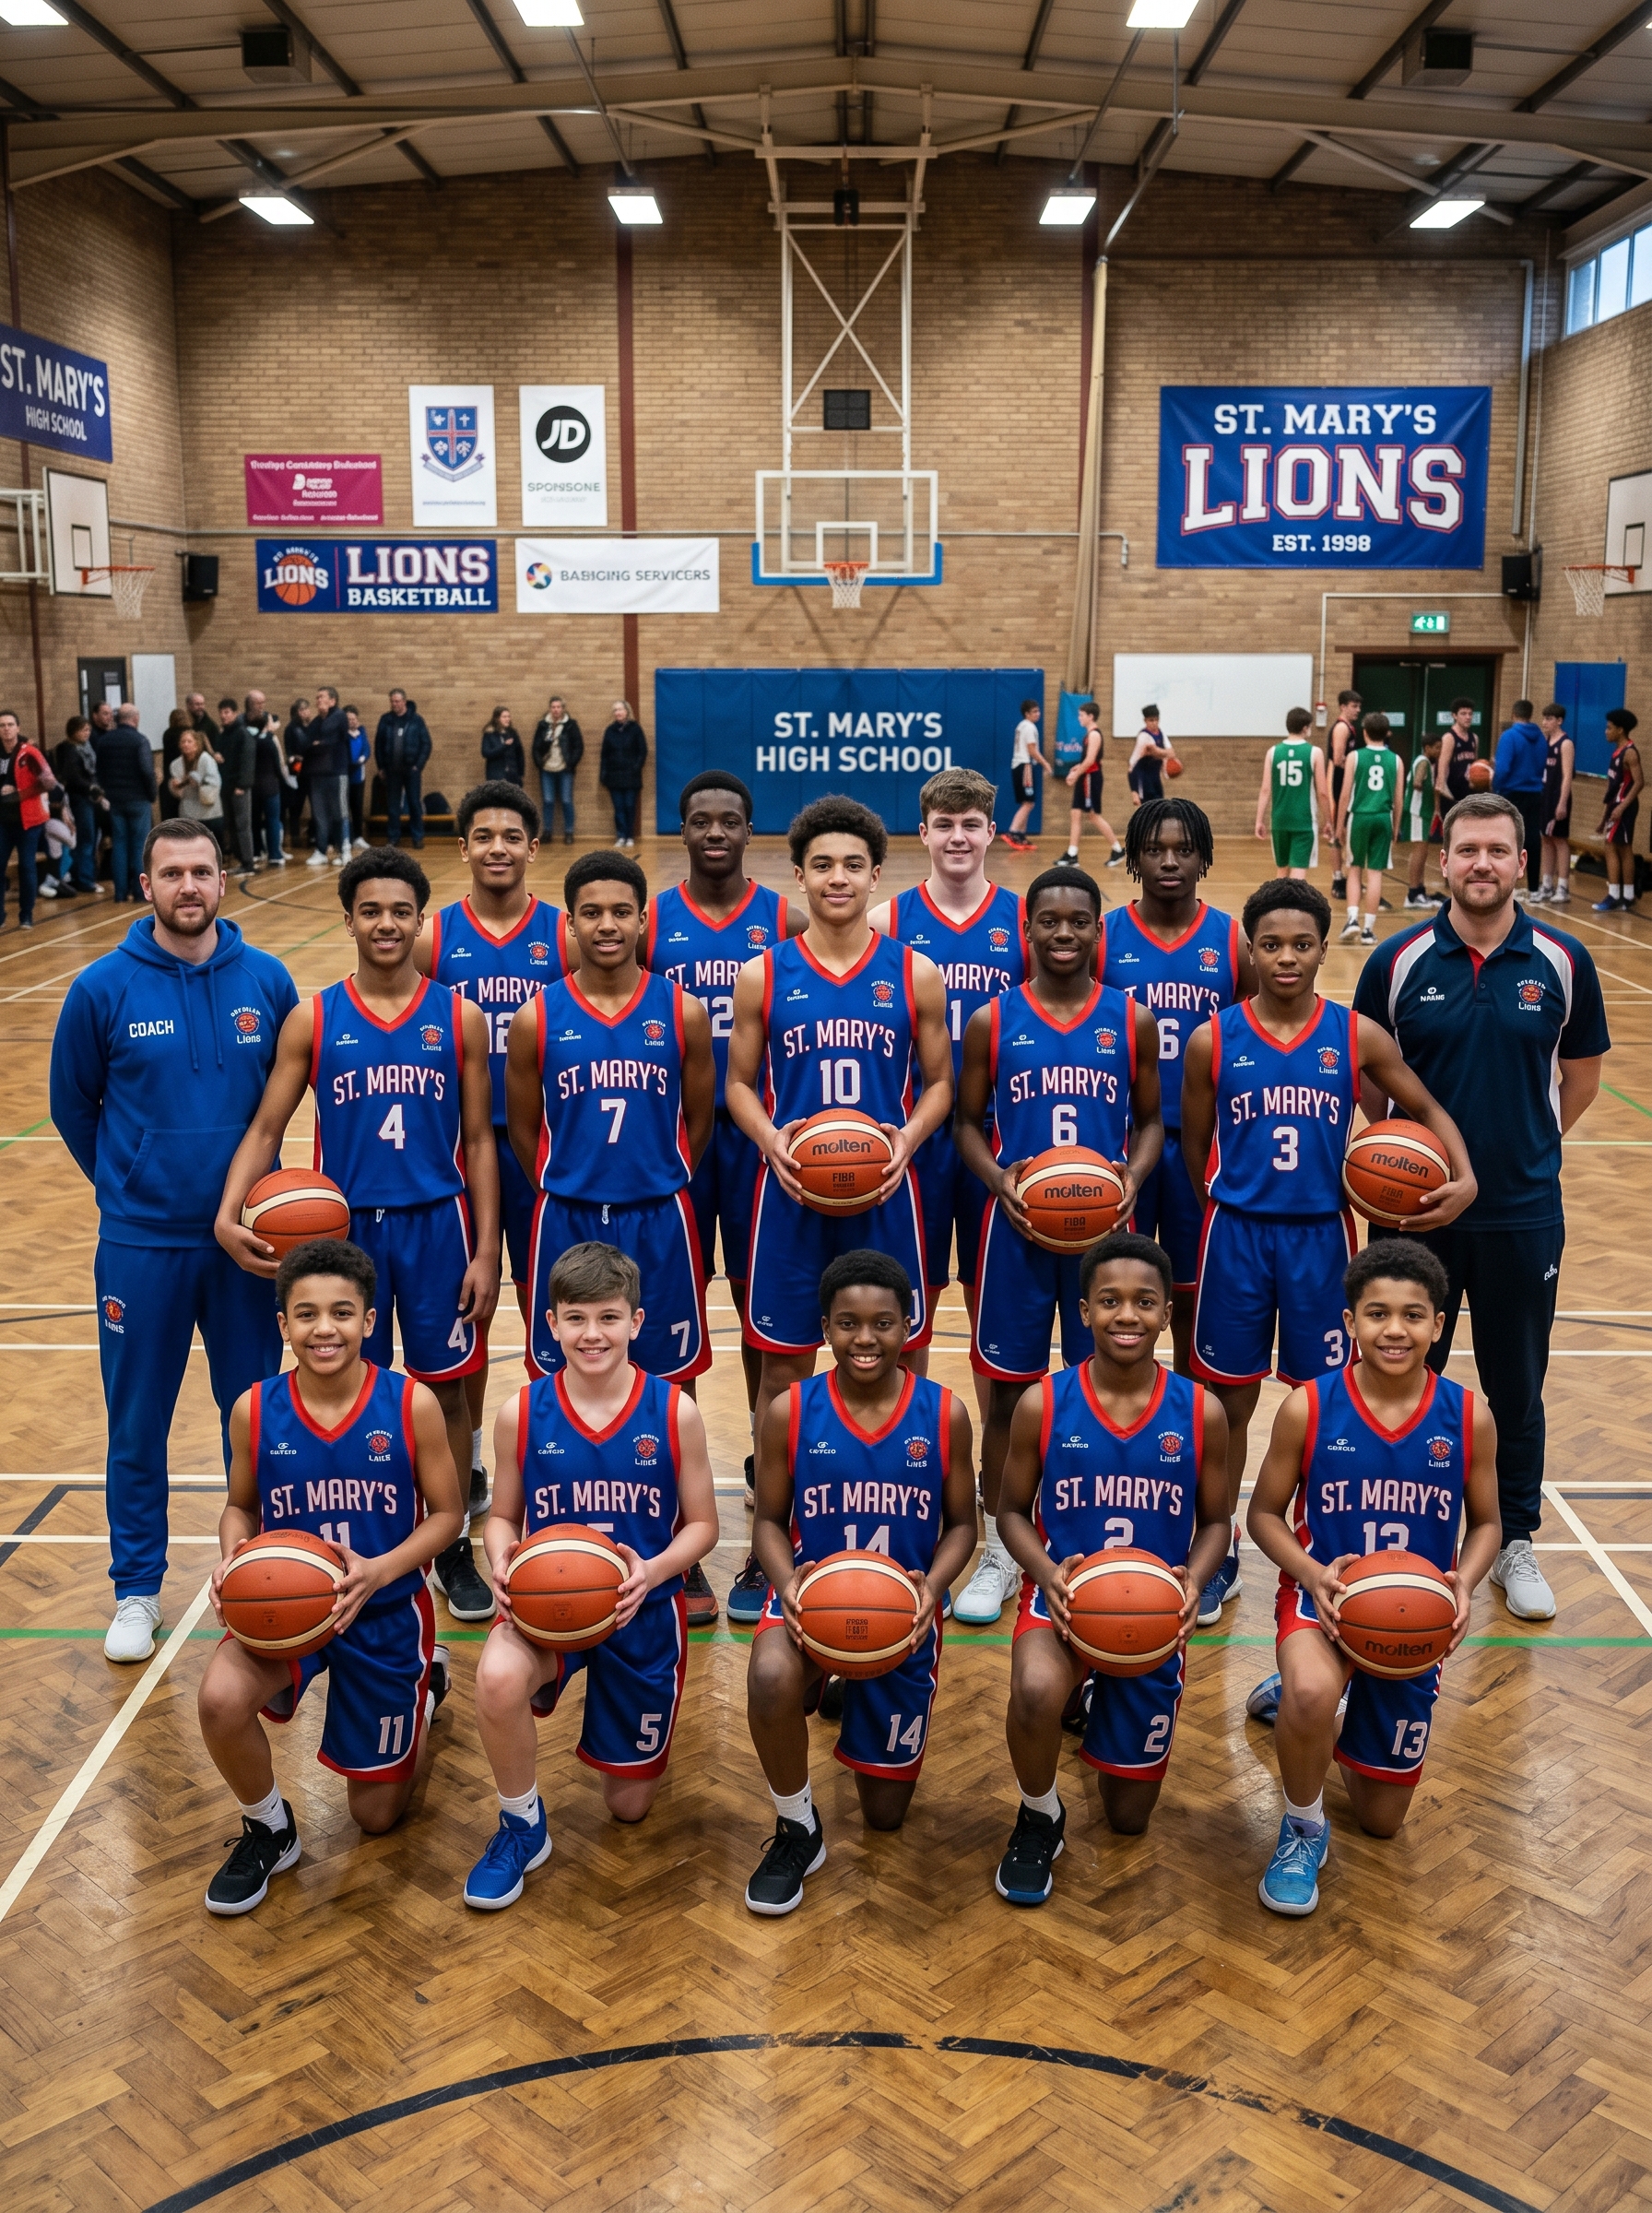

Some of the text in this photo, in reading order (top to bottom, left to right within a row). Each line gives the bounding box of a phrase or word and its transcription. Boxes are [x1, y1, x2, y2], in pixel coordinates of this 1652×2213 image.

[0, 343, 106, 418] ST. MARY'S
[25, 405, 88, 442] HIGH SCHOOL
[540, 419, 586, 450] JD
[1213, 404, 1437, 435] ST. MARY'S
[1181, 444, 1466, 535] LIONS
[1272, 535, 1372, 552] EST. 1998
[264, 564, 329, 590] LIONS
[346, 545, 490, 585] LIONS
[347, 587, 491, 607] BASKETBALL
[773, 711, 943, 739] ST. MARY'S
[756, 745, 962, 773] HIGH SCHOOL
[1276, 760, 1304, 787] 15
[1367, 764, 1385, 791] 8
[1147, 982, 1220, 1016] MARY'S
[128, 1019, 174, 1038] COACH
[783, 1018, 895, 1059] ST. MARY'S
[1156, 1017, 1180, 1059] 6
[333, 1064, 445, 1106] ST. MARY'S
[558, 1059, 668, 1100] ST. MARY'S
[820, 1059, 861, 1105] 10
[1009, 1066, 1117, 1104] ST. MARY'S
[600, 1098, 627, 1143] 7
[1230, 1085, 1339, 1125] ST. MARY'S
[378, 1104, 406, 1150] 4
[1052, 1104, 1078, 1147] 6
[812, 1139, 871, 1156] molten
[1272, 1126, 1298, 1171] 3
[1370, 1153, 1430, 1179] molten
[832, 1172, 856, 1182] FIBA
[1044, 1184, 1103, 1199] molten
[447, 1317, 467, 1353] 4
[670, 1320, 690, 1358] 7
[1324, 1329, 1344, 1367] 3
[270, 1478, 397, 1519] ST. MARY'S
[535, 1480, 661, 1520] ST. MARY'S
[804, 1481, 931, 1521] ST. MARY'S
[1056, 1474, 1183, 1516] ST. MARY'S
[1321, 1478, 1452, 1521] ST. MARY'S
[1364, 1639, 1433, 1657] molten
[377, 1714, 405, 1755] 11
[635, 1713, 663, 1752] 5
[886, 1713, 924, 1754] 14
[1143, 1714, 1171, 1753] 2
[1391, 1719, 1428, 1758] 13
